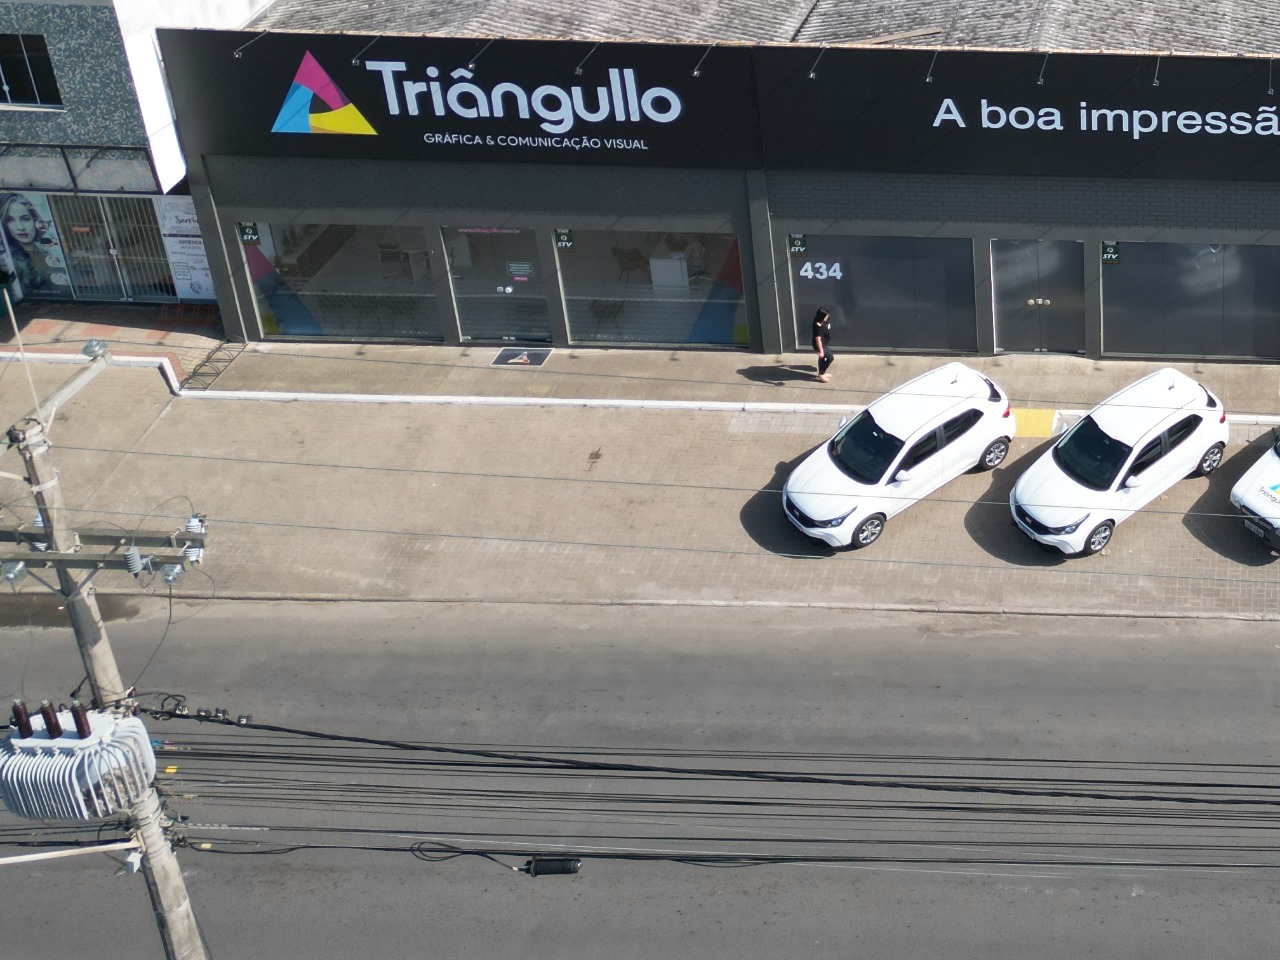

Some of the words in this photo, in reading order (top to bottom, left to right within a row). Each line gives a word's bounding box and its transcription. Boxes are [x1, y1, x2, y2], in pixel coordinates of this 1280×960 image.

[365, 60, 682, 134] Triângullo
[932, 98, 966, 128] A
[980, 98, 1064, 131] boa
[424, 131, 483, 145] GRÁFICA
[485, 135, 495, 145] &
[497, 131, 601, 151] COMUNICAÇÃO
[603, 138, 648, 150] VISUAL
[799, 261, 843, 280] 434
